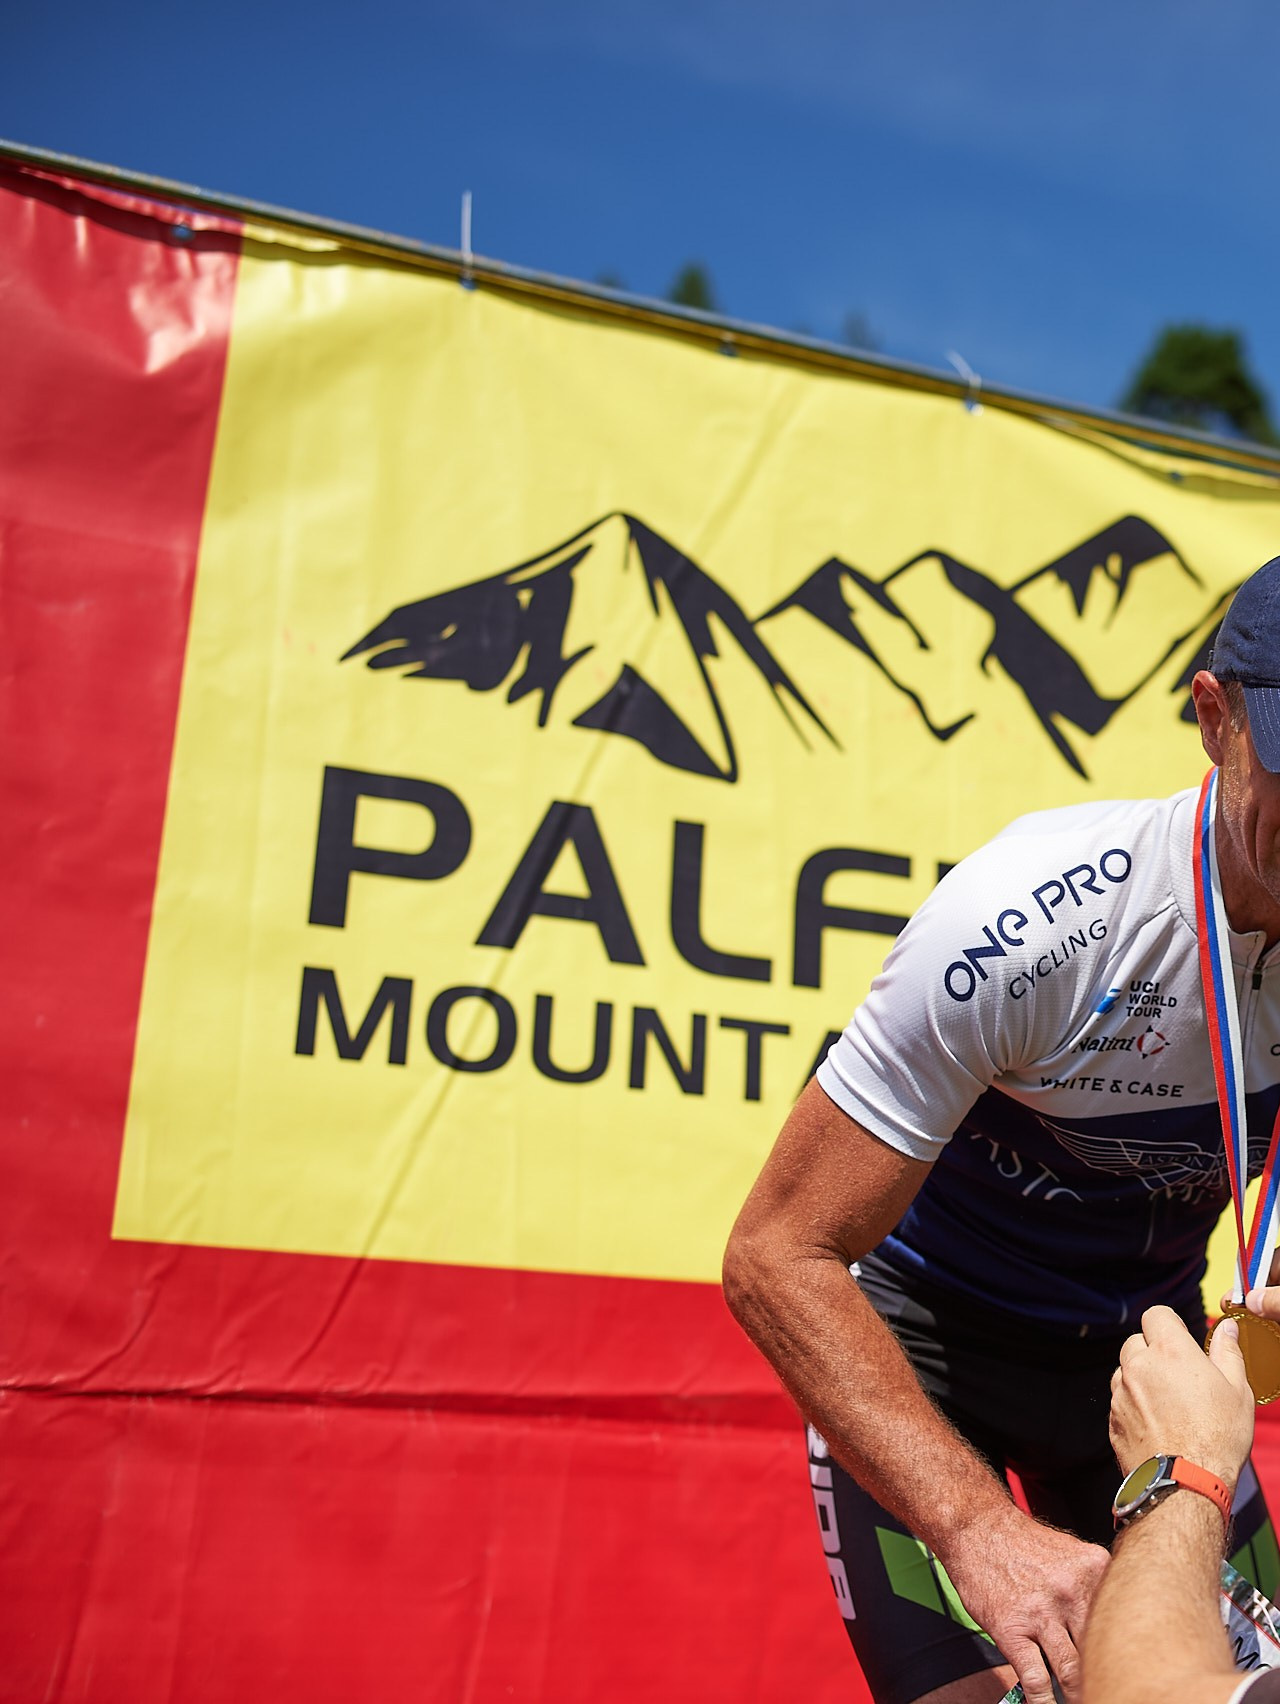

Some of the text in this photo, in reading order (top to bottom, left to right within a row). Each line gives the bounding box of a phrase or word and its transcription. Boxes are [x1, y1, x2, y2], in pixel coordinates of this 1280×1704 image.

[308, 765, 960, 990] PALF
[1031, 848, 1132, 925] PRO
[1009, 918, 1108, 1000] CYCLING
[1129, 980, 1161, 994] UCI
[1129, 993, 1178, 1008] WORLD
[1126, 1006, 1162, 1019] TOUR
[1071, 1036, 1137, 1054] Nalini
[1040, 1076, 1185, 1098] WHITE & CASE
